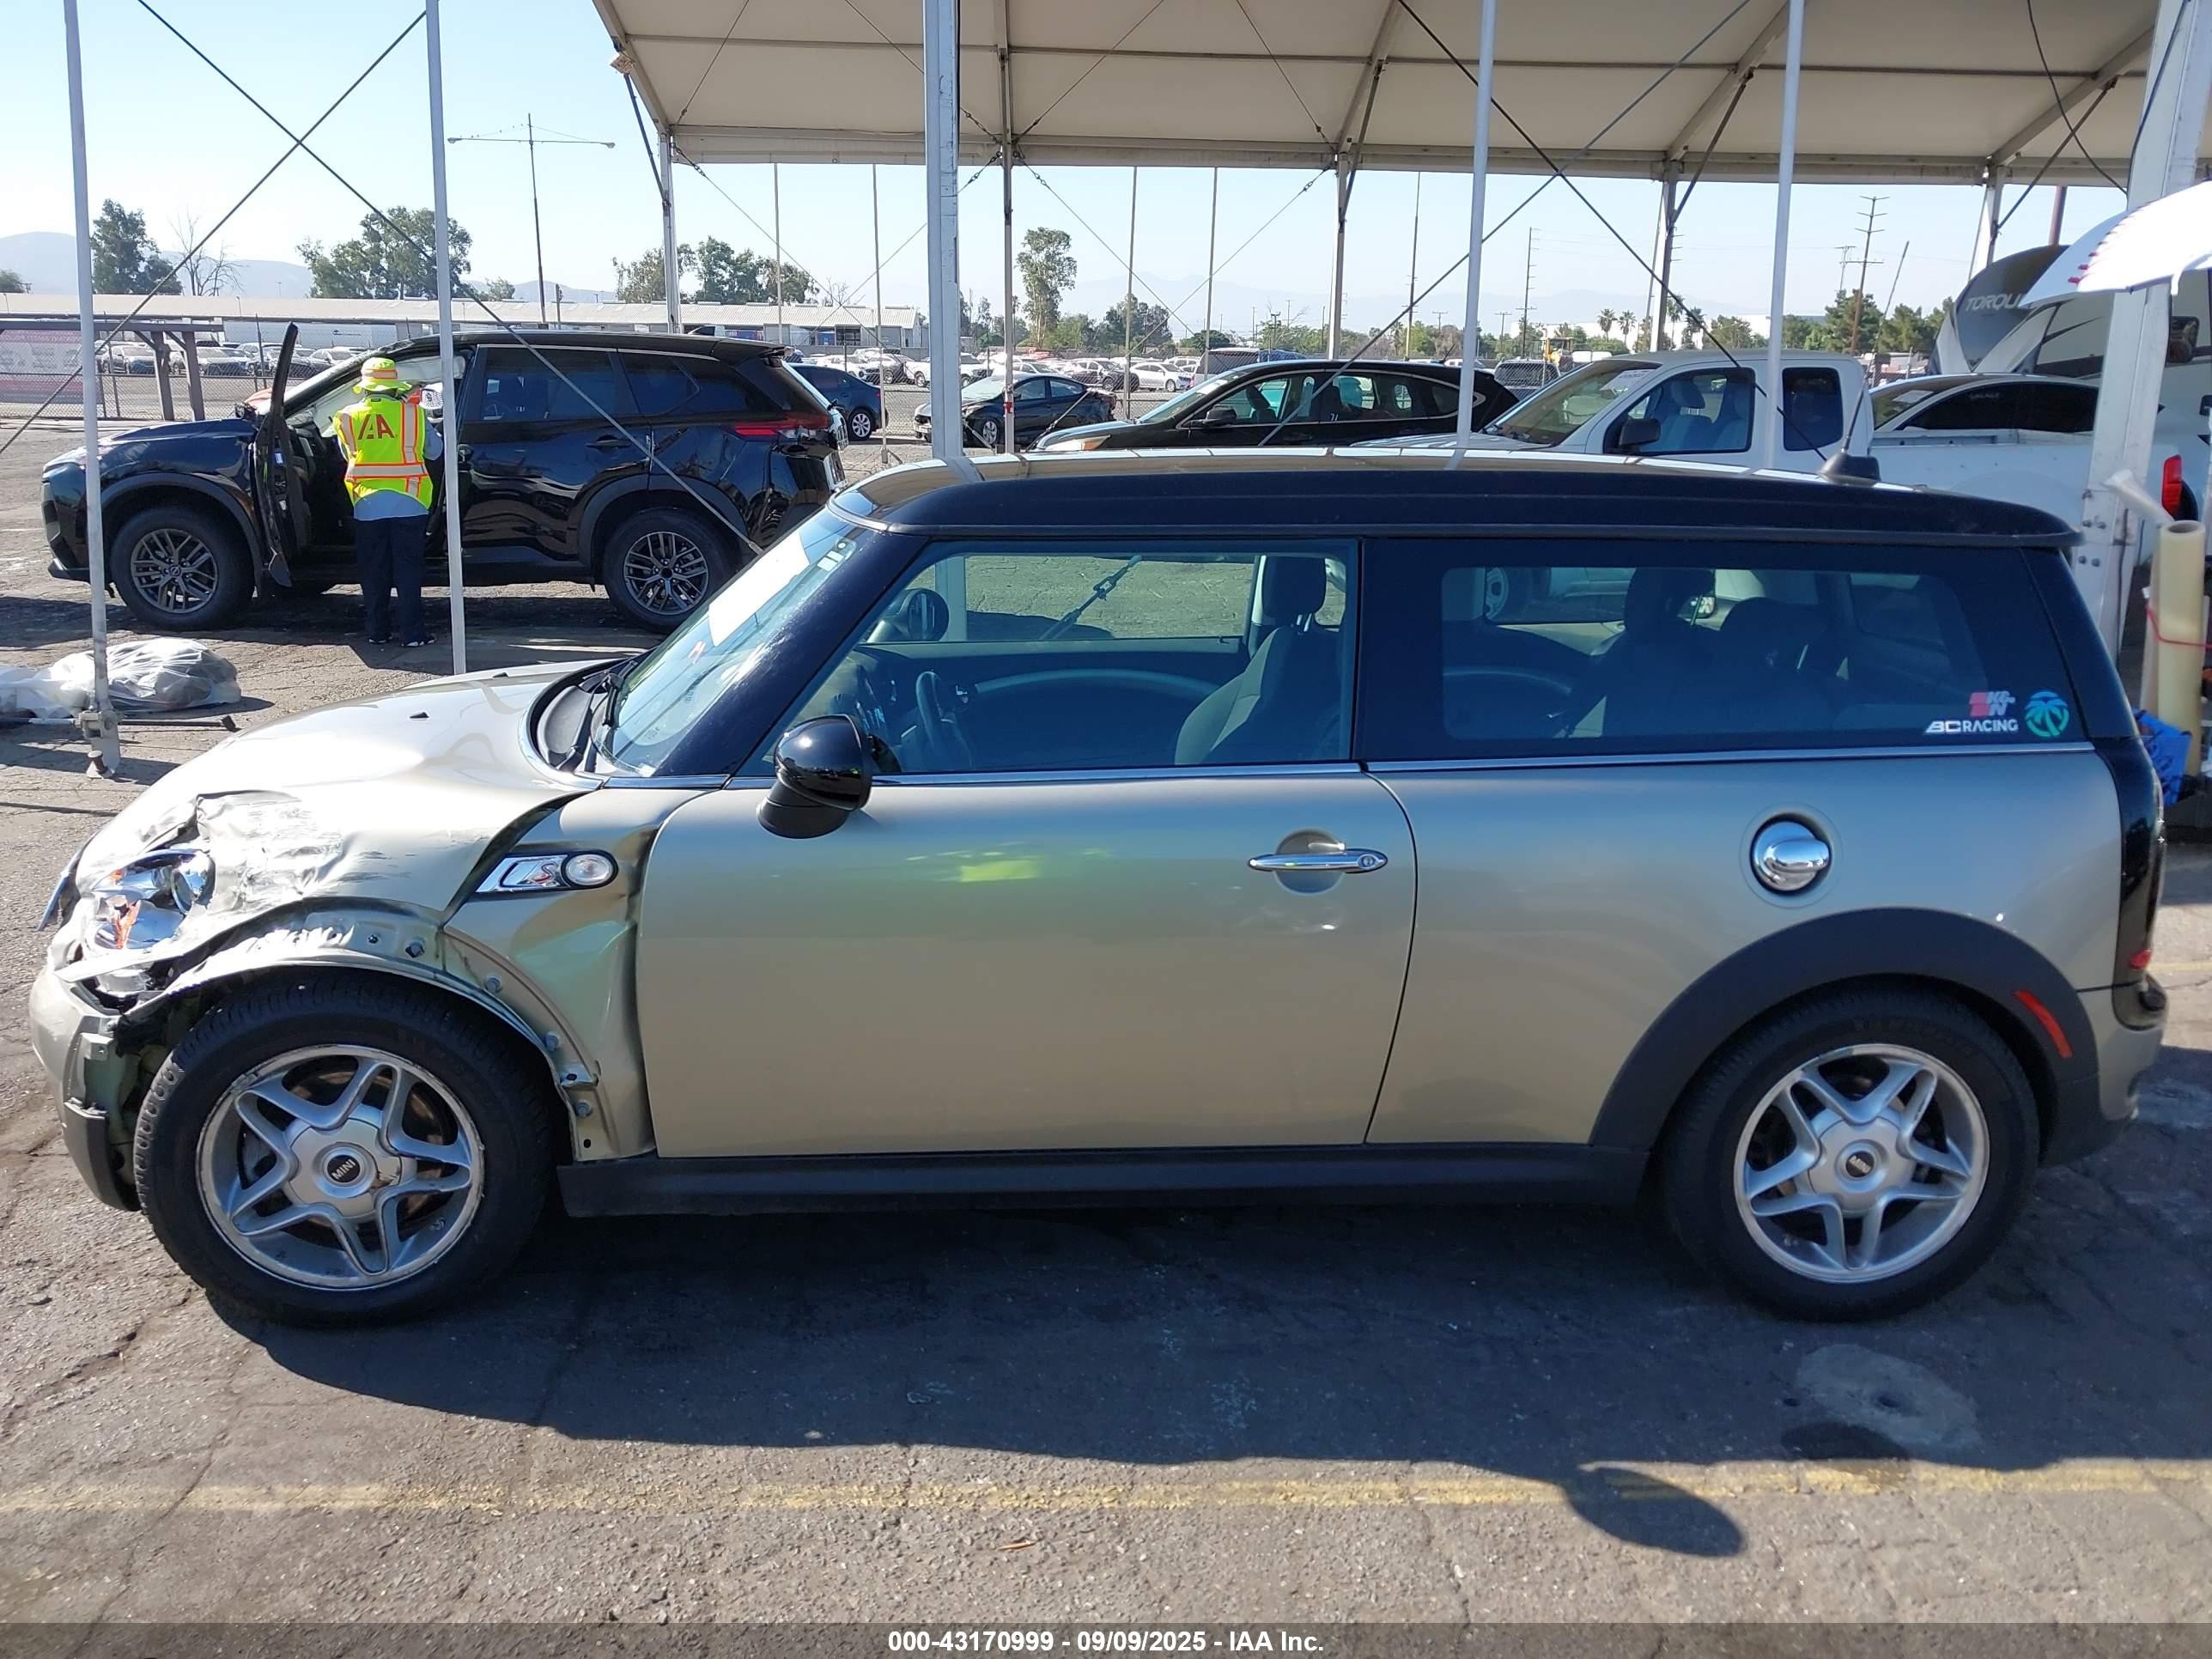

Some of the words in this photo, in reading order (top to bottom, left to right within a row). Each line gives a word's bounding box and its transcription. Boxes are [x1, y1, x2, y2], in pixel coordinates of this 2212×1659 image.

[1966, 293, 2021, 311] TORQU
[1963, 719, 2019, 732] RACING
[331, 1158, 356, 1180] MINI
